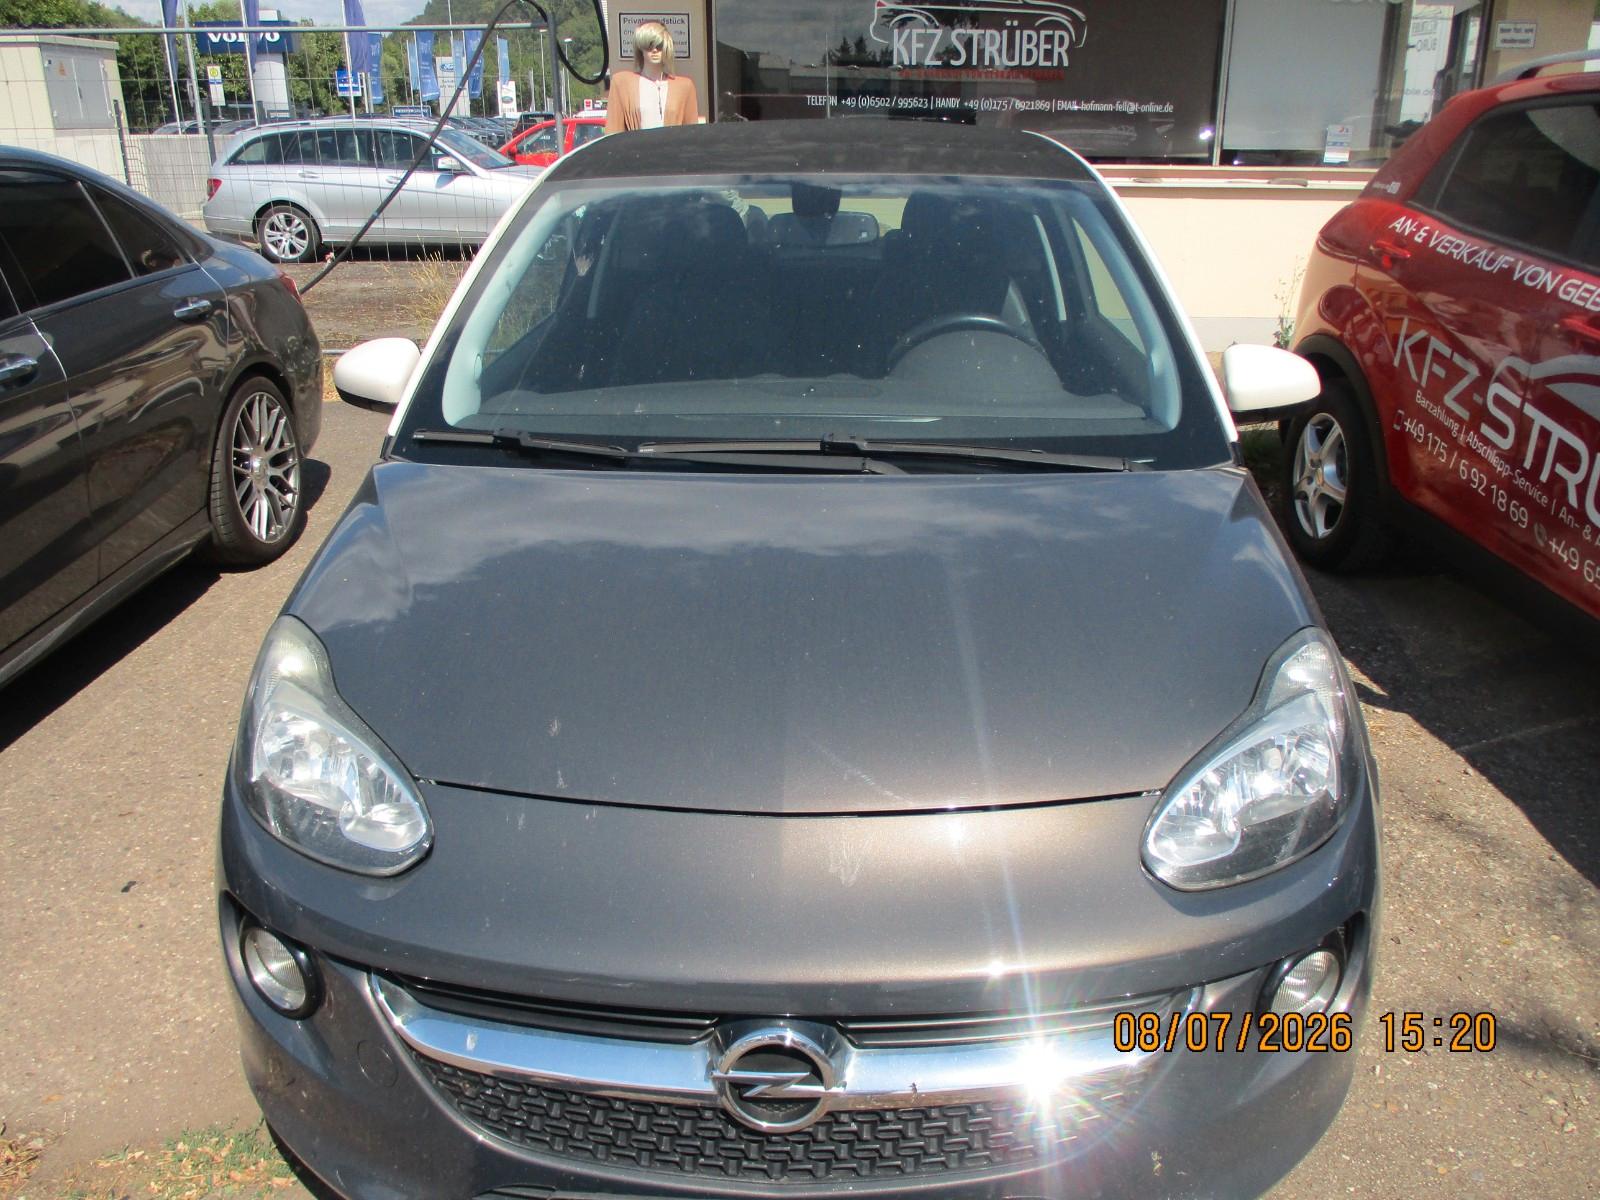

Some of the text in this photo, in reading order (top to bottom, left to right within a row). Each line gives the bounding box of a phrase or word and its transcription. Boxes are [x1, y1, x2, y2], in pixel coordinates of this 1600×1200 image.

[207, 31, 281, 43] VOLO
[893, 19, 1070, 67] KFZ STRÜBER
[841, 98, 856, 108] +49
[858, 95, 890, 109] (0)6502
[898, 97, 928, 109] 995623
[935, 97, 960, 109] HANDY
[964, 99, 979, 110] +49
[980, 98, 1008, 111] (0)175
[1015, 100, 1050, 112] 6921869
[1414, 225, 1430, 244] &
[1428, 230, 1514, 274] VERKAUF
[1512, 260, 1562, 294] VON
[1403, 417, 1425, 443] +49
[1427, 432, 1448, 463] 175
[1459, 459, 1469, 480] 6
[1470, 467, 1487, 497] 92
[1490, 484, 1508, 512] 18
[1509, 500, 1529, 529] 69
[1415, 389, 1460, 438] Barzahlung
[1465, 431, 1549, 508] Abschlepp-Service
[1558, 506, 1580, 530] An-
[1582, 524, 1592, 540] &
[1549, 538, 1580, 571] +49
